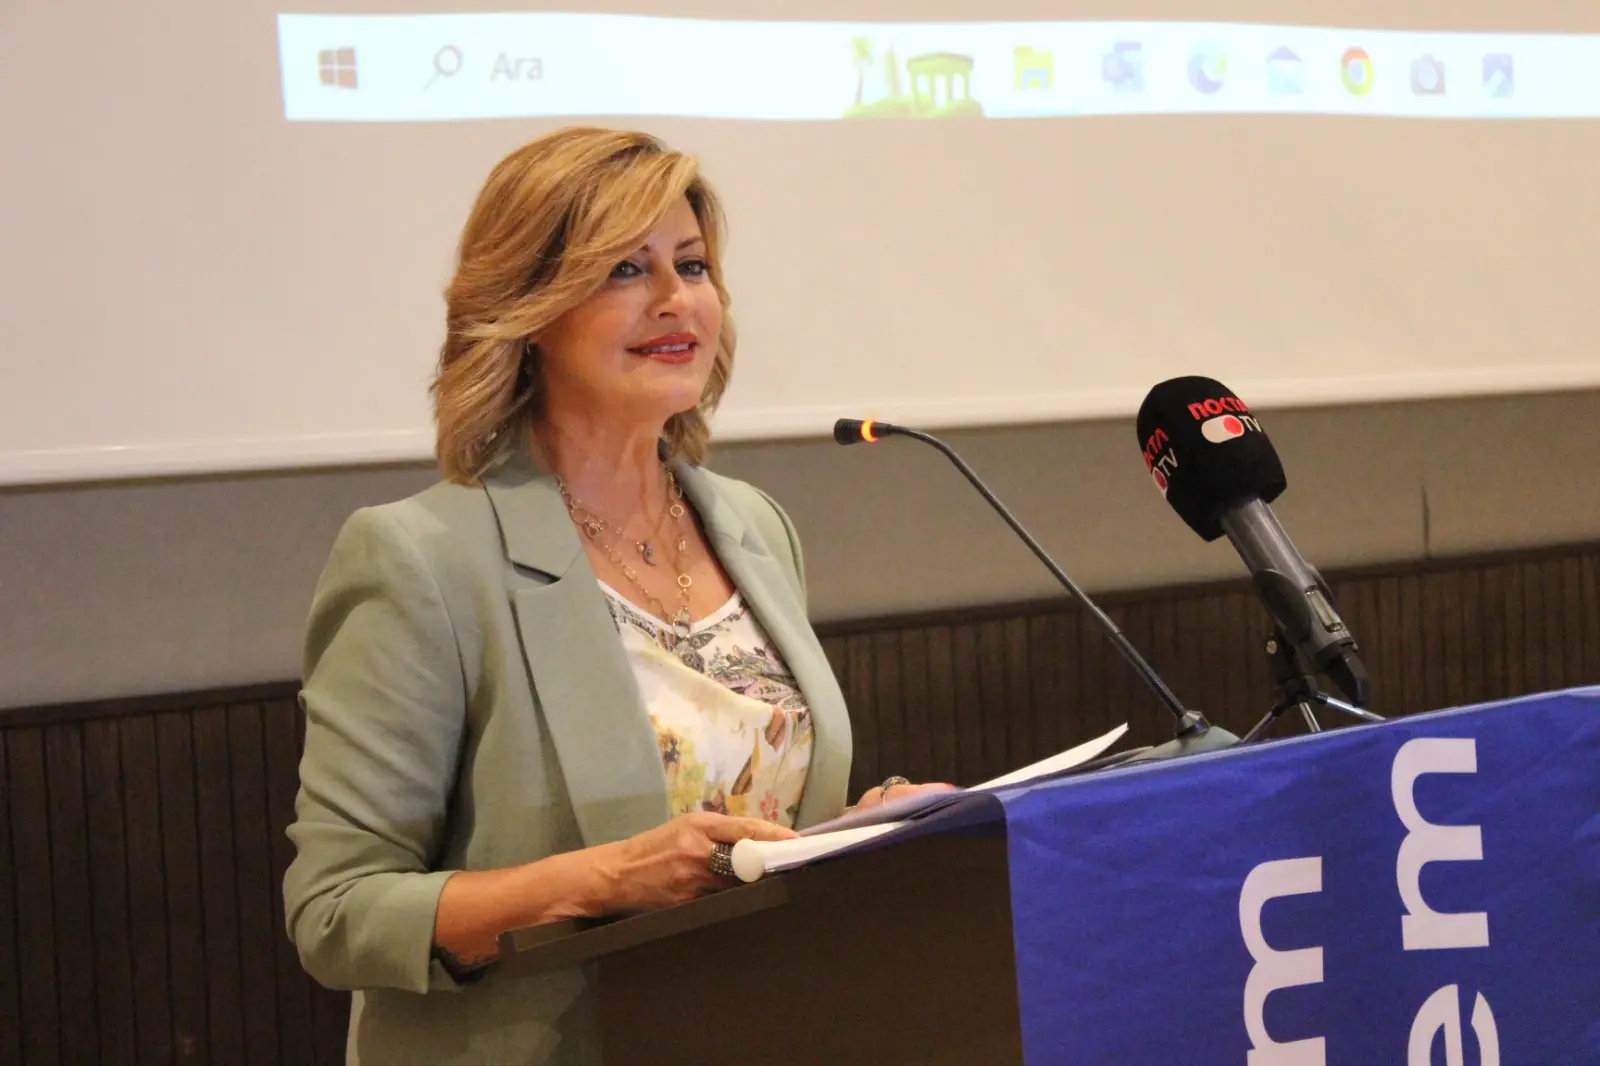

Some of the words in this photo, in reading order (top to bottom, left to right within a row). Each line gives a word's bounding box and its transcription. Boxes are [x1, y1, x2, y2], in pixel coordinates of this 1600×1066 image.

[490, 51, 543, 81] Ara
[1238, 415, 1261, 432] TV
[1158, 447, 1178, 476] TV
